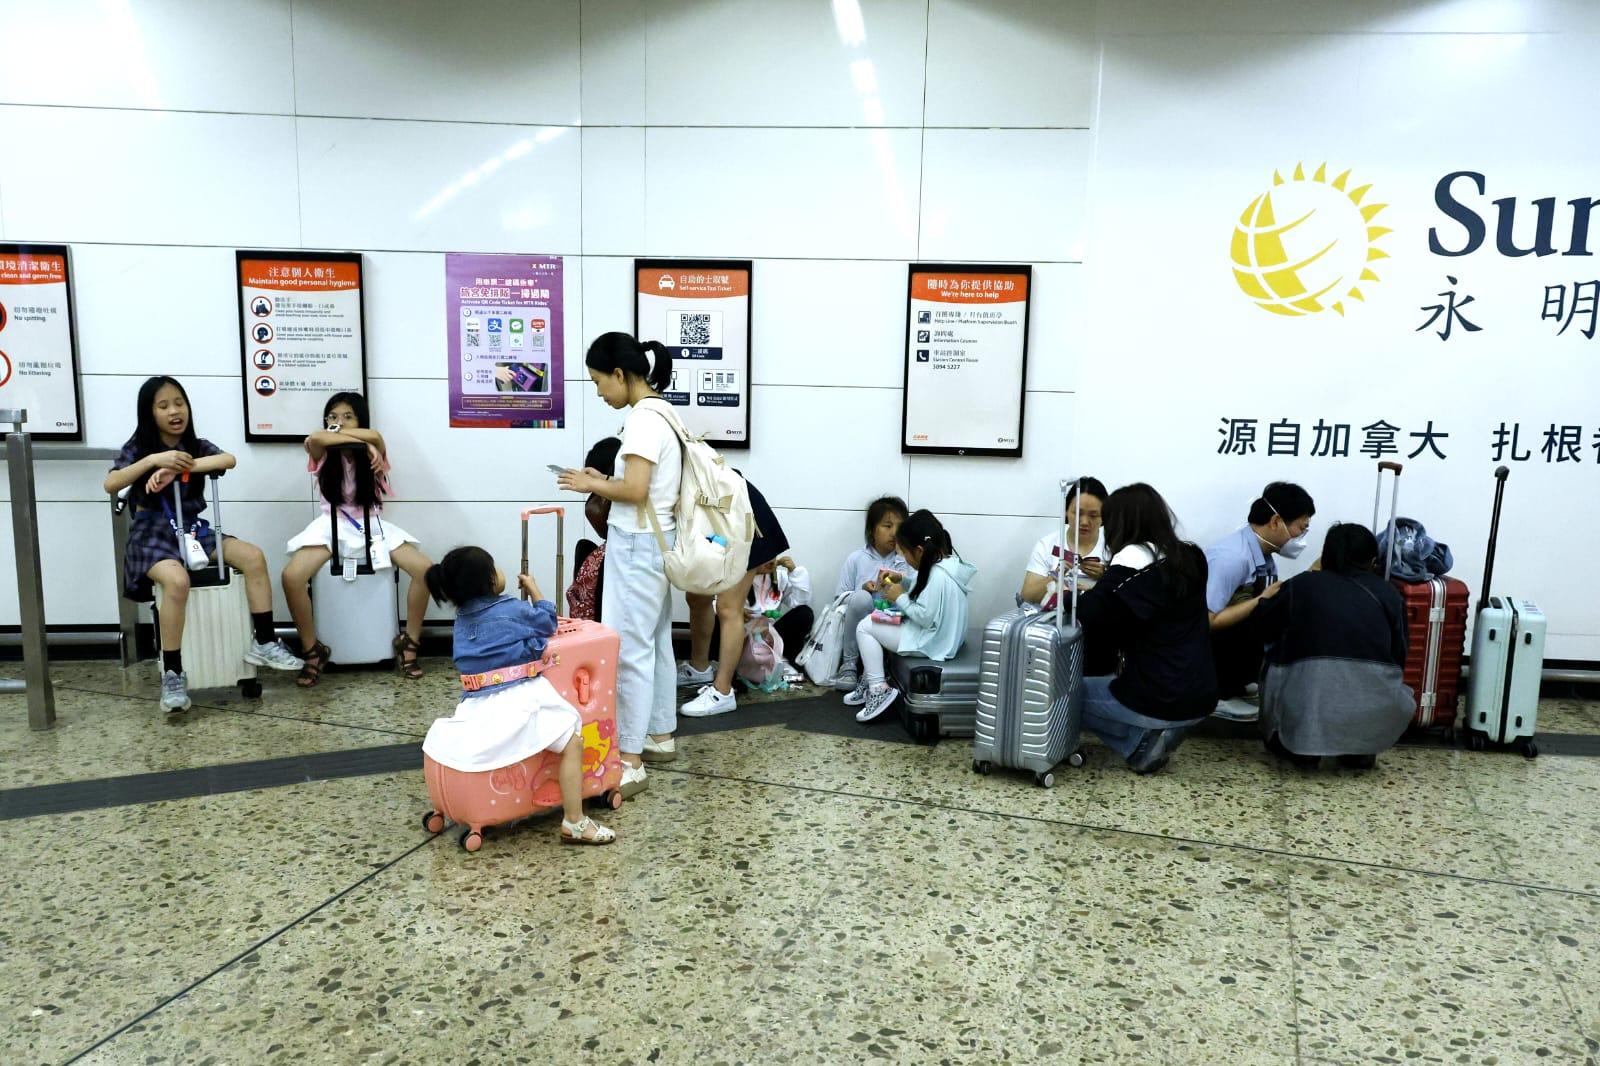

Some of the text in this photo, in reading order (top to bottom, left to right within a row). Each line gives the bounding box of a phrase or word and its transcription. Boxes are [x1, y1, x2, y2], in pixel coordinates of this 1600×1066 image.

[269, 267, 335, 279] 注意個人衛生
[248, 278, 356, 288] Maintain good personal hygiene
[928, 279, 1015, 291] 隨時為你提供協助
[941, 290, 959, 298] We're
[960, 290, 975, 298] here
[984, 291, 1000, 299] help
[1217, 417, 1449, 460] 源自加拿大
